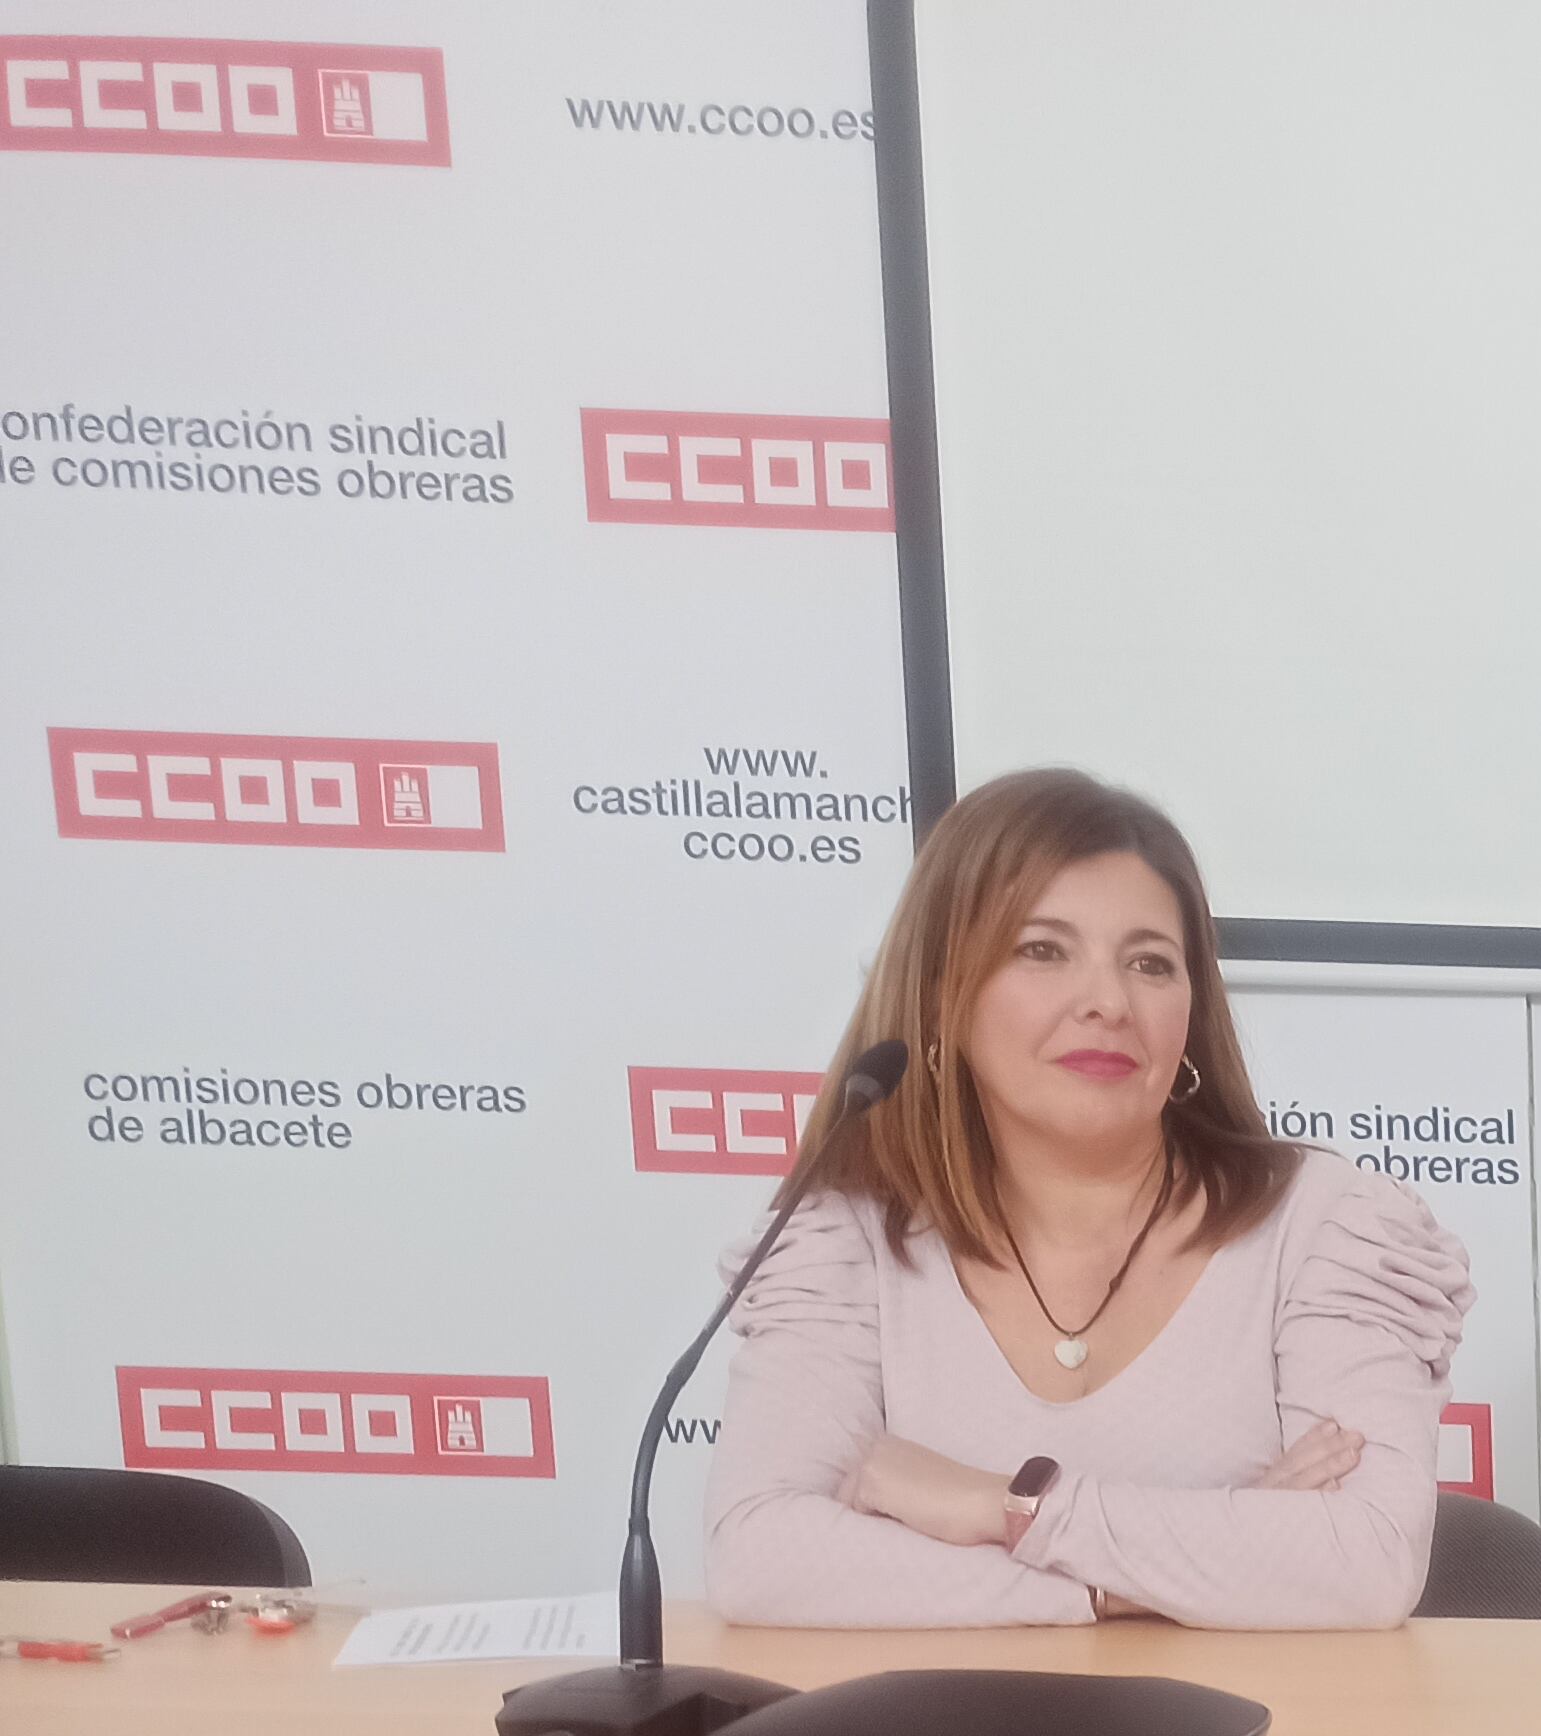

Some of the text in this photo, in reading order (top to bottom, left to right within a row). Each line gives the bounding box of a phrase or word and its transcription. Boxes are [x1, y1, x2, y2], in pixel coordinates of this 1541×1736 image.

[6, 59, 298, 138] CCOO
[1, 403, 507, 460] onfederación sindical
[52, 453, 321, 497] comisiones
[337, 459, 514, 504] obreras
[605, 433, 890, 509] CCOO
[703, 747, 828, 779] www.
[73, 751, 361, 827] CCOO
[683, 831, 862, 865] ccoo.es
[83, 1066, 527, 1113] comisiones obreras
[87, 1105, 353, 1149] de albacete
[1349, 1104, 1516, 1145] sindical
[140, 1387, 414, 1456] CCOO
